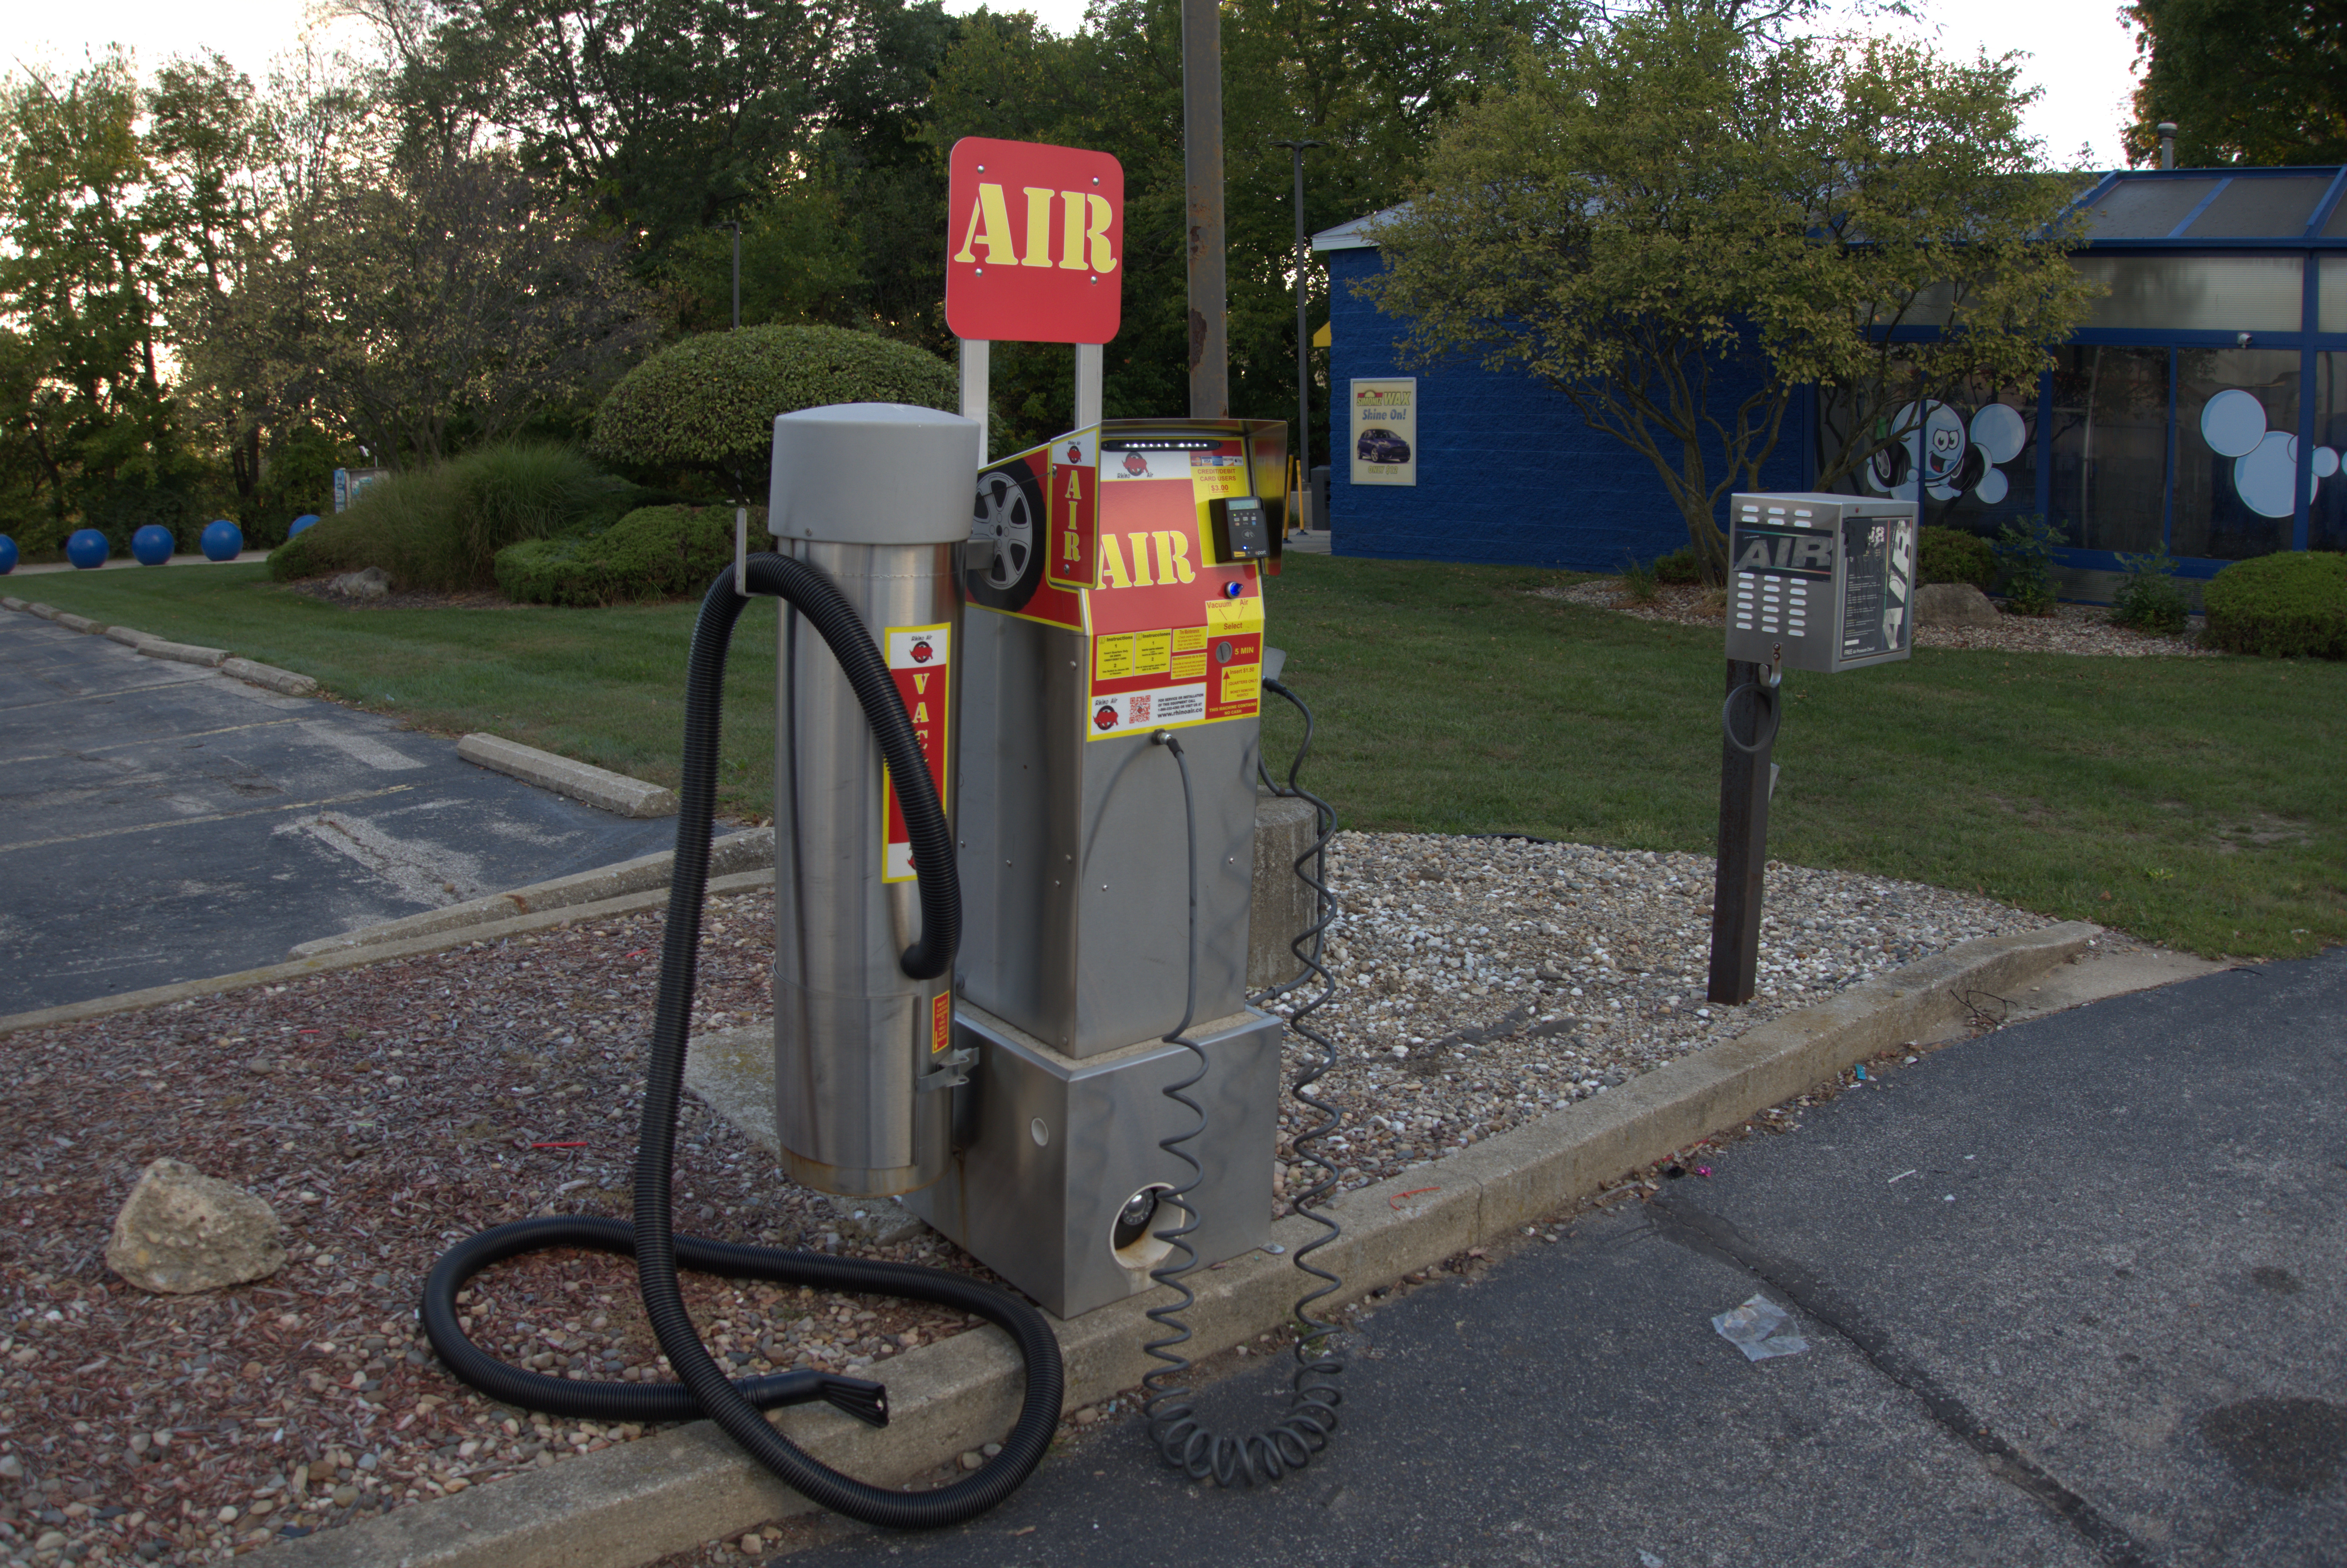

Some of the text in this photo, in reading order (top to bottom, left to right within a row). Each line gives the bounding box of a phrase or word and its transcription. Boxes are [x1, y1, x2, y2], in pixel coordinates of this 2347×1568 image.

[954, 183, 1117, 273] AIR
[1357, 392, 1411, 406] SIMONIZ WAX
[1362, 409, 1407, 420] Shine On!
[1386, 465, 1398, 475] $12
[1063, 470, 1082, 562] AIR
[1095, 530, 1195, 590] AIR
[1733, 535, 1833, 571] AIR
[1241, 646, 1254, 654] MIN
[1157, 708, 1203, 718] www.rhinoair.co
